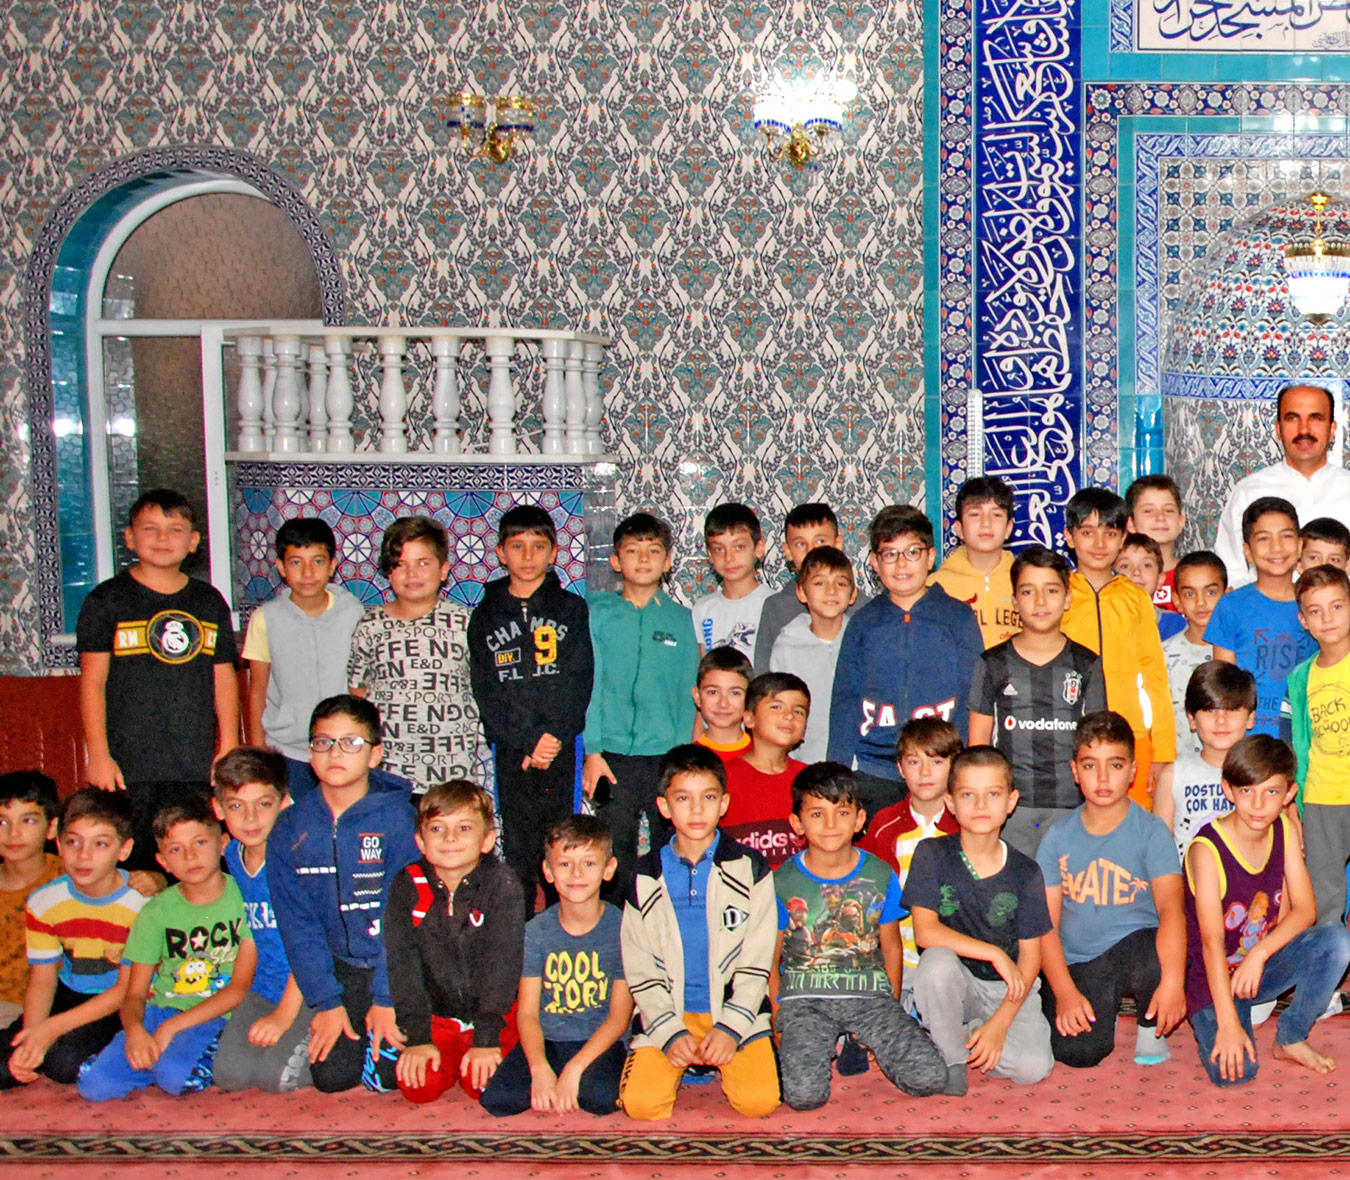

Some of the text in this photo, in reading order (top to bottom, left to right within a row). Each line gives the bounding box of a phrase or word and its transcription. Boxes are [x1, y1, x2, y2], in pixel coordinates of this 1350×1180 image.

[1311, 698, 1347, 724] BACK
[1018, 717, 1078, 730] vodafone
[1185, 784, 1224, 798] DOSTU
[363, 836, 380, 849] GO
[360, 848, 383, 861] WAY
[165, 917, 243, 960] ROCK
[545, 950, 605, 985] COOL
